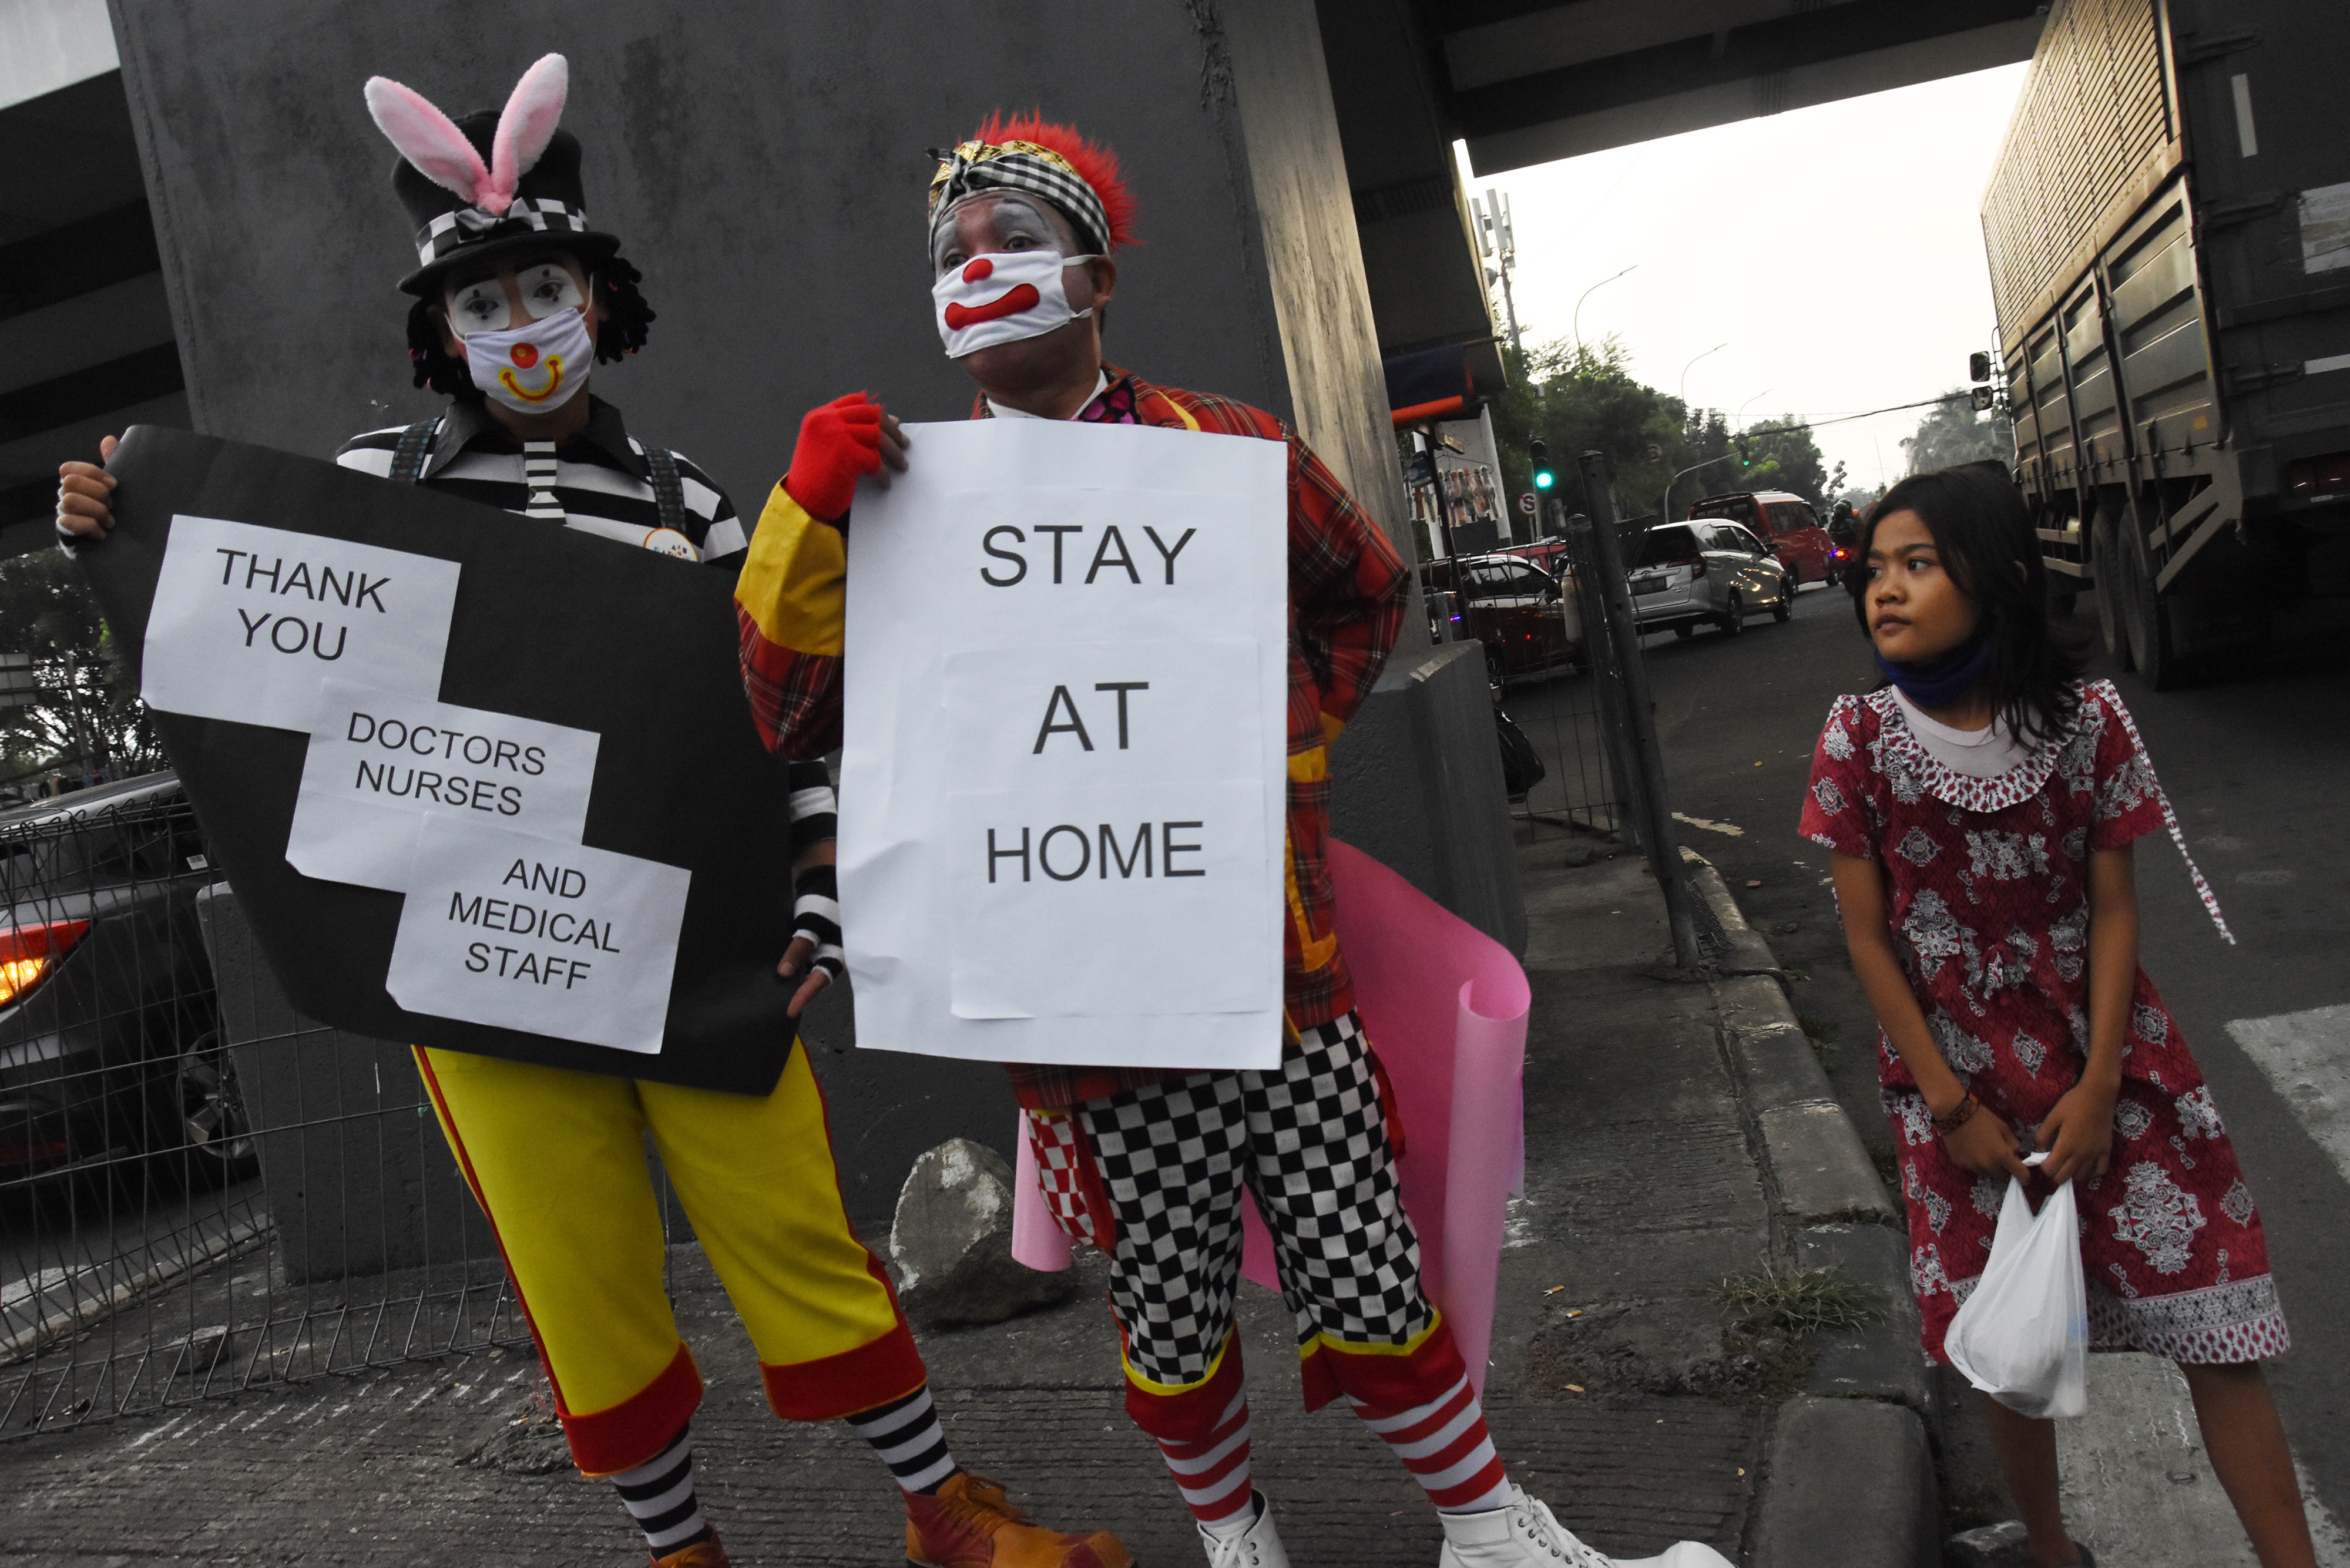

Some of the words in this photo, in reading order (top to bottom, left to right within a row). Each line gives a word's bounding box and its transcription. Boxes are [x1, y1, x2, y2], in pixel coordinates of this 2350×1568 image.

[217, 548, 391, 613] THANK
[981, 525, 1197, 587] STAY
[238, 608, 347, 661] YOU
[347, 711, 546, 775] DOCTORS
[1033, 681, 1149, 754] AT
[355, 760, 522, 816] NURSES
[502, 858, 586, 899] AND
[988, 821, 1206, 883] HOME
[448, 891, 620, 954] MEDICAL
[465, 942, 592, 990] STAFF
